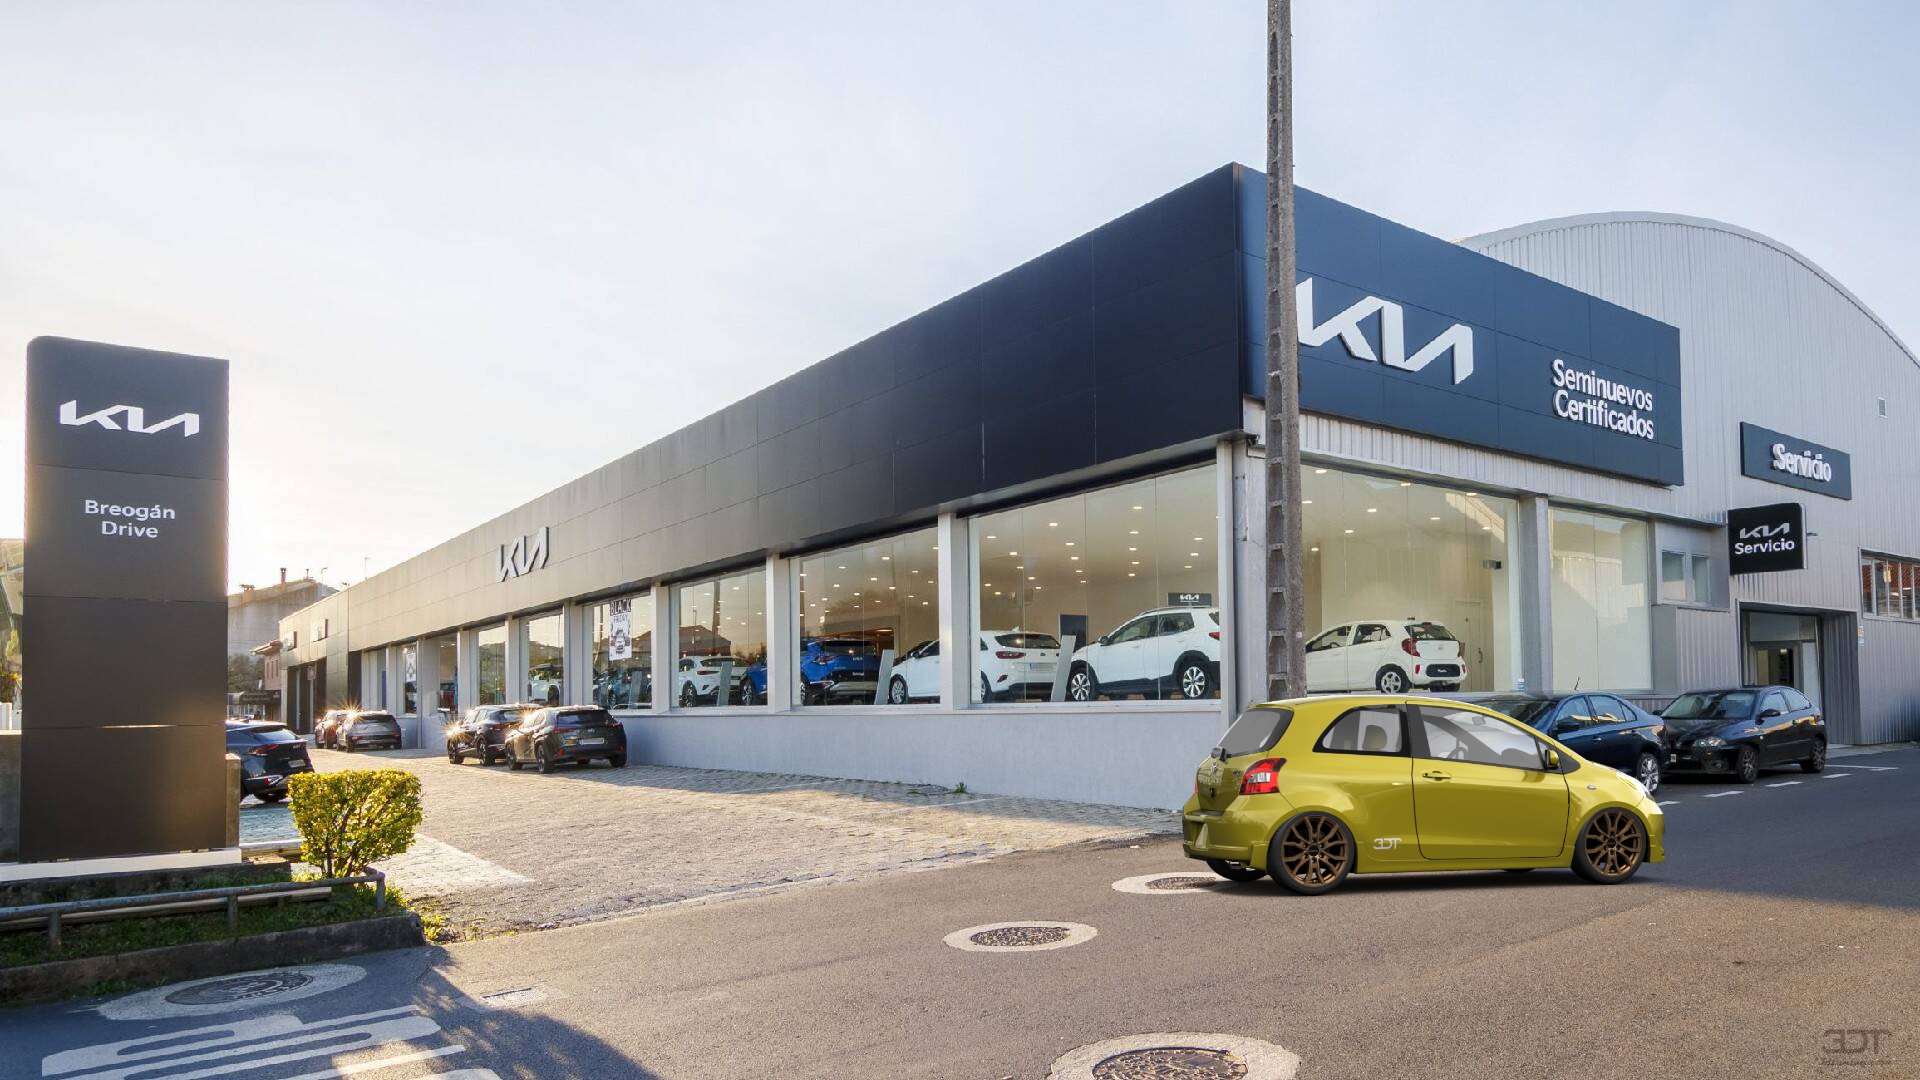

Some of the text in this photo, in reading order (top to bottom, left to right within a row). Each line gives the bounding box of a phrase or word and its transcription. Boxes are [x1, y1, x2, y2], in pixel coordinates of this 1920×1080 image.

[1296, 277, 1475, 386] KIA
[1552, 359, 1653, 411] Seminuevos
[60, 399, 200, 437] KIA
[1553, 389, 1655, 440] Certificados
[1771, 443, 1832, 483] Servicio
[84, 499, 176, 522] Breogán
[101, 521, 159, 538] Drive
[1734, 538, 1795, 555] Servicio
[1739, 522, 1790, 539] KIA
[496, 526, 550, 583] KIA
[610, 599, 632, 616] BLACK
